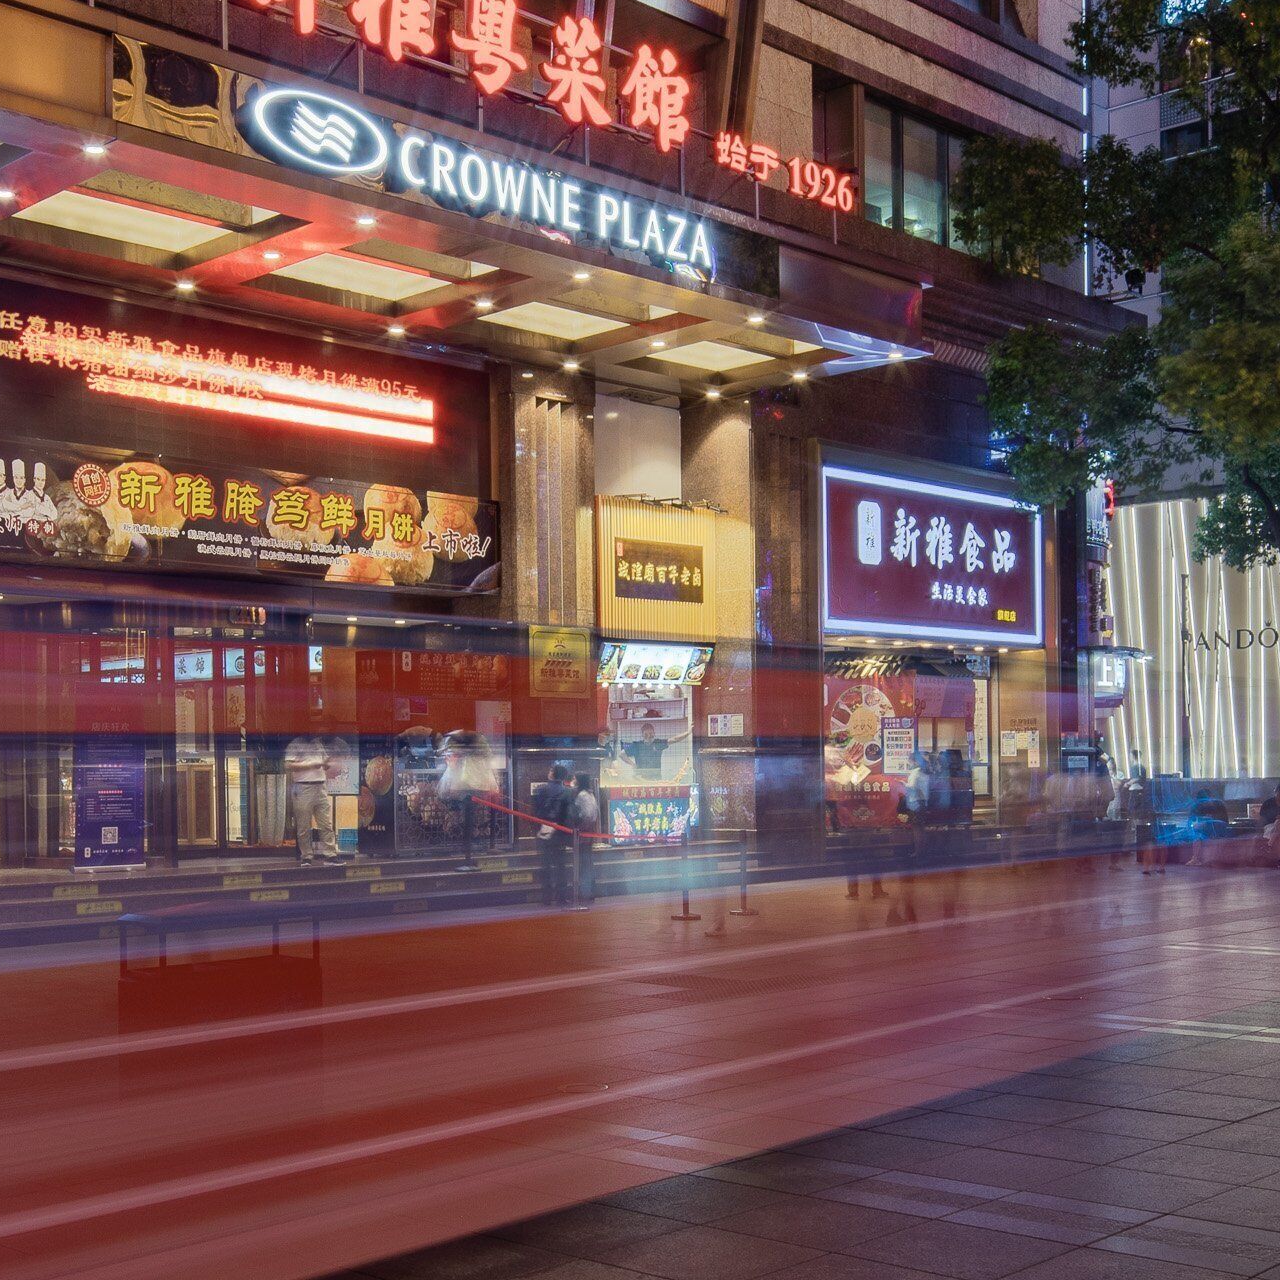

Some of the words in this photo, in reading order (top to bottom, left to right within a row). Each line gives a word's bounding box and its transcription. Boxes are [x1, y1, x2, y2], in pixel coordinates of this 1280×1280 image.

[400, 135, 581, 231] CROWNE
[598, 194, 712, 267] PLAZA
[716, 131, 779, 183] 始于
[787, 157, 856, 213] 1926
[80, 472, 100, 485] 首创
[119, 469, 415, 544] 新雅腌笃鲜月饼
[889, 507, 1016, 574] 新雅食品
[931, 581, 989, 607] 生活美食家
